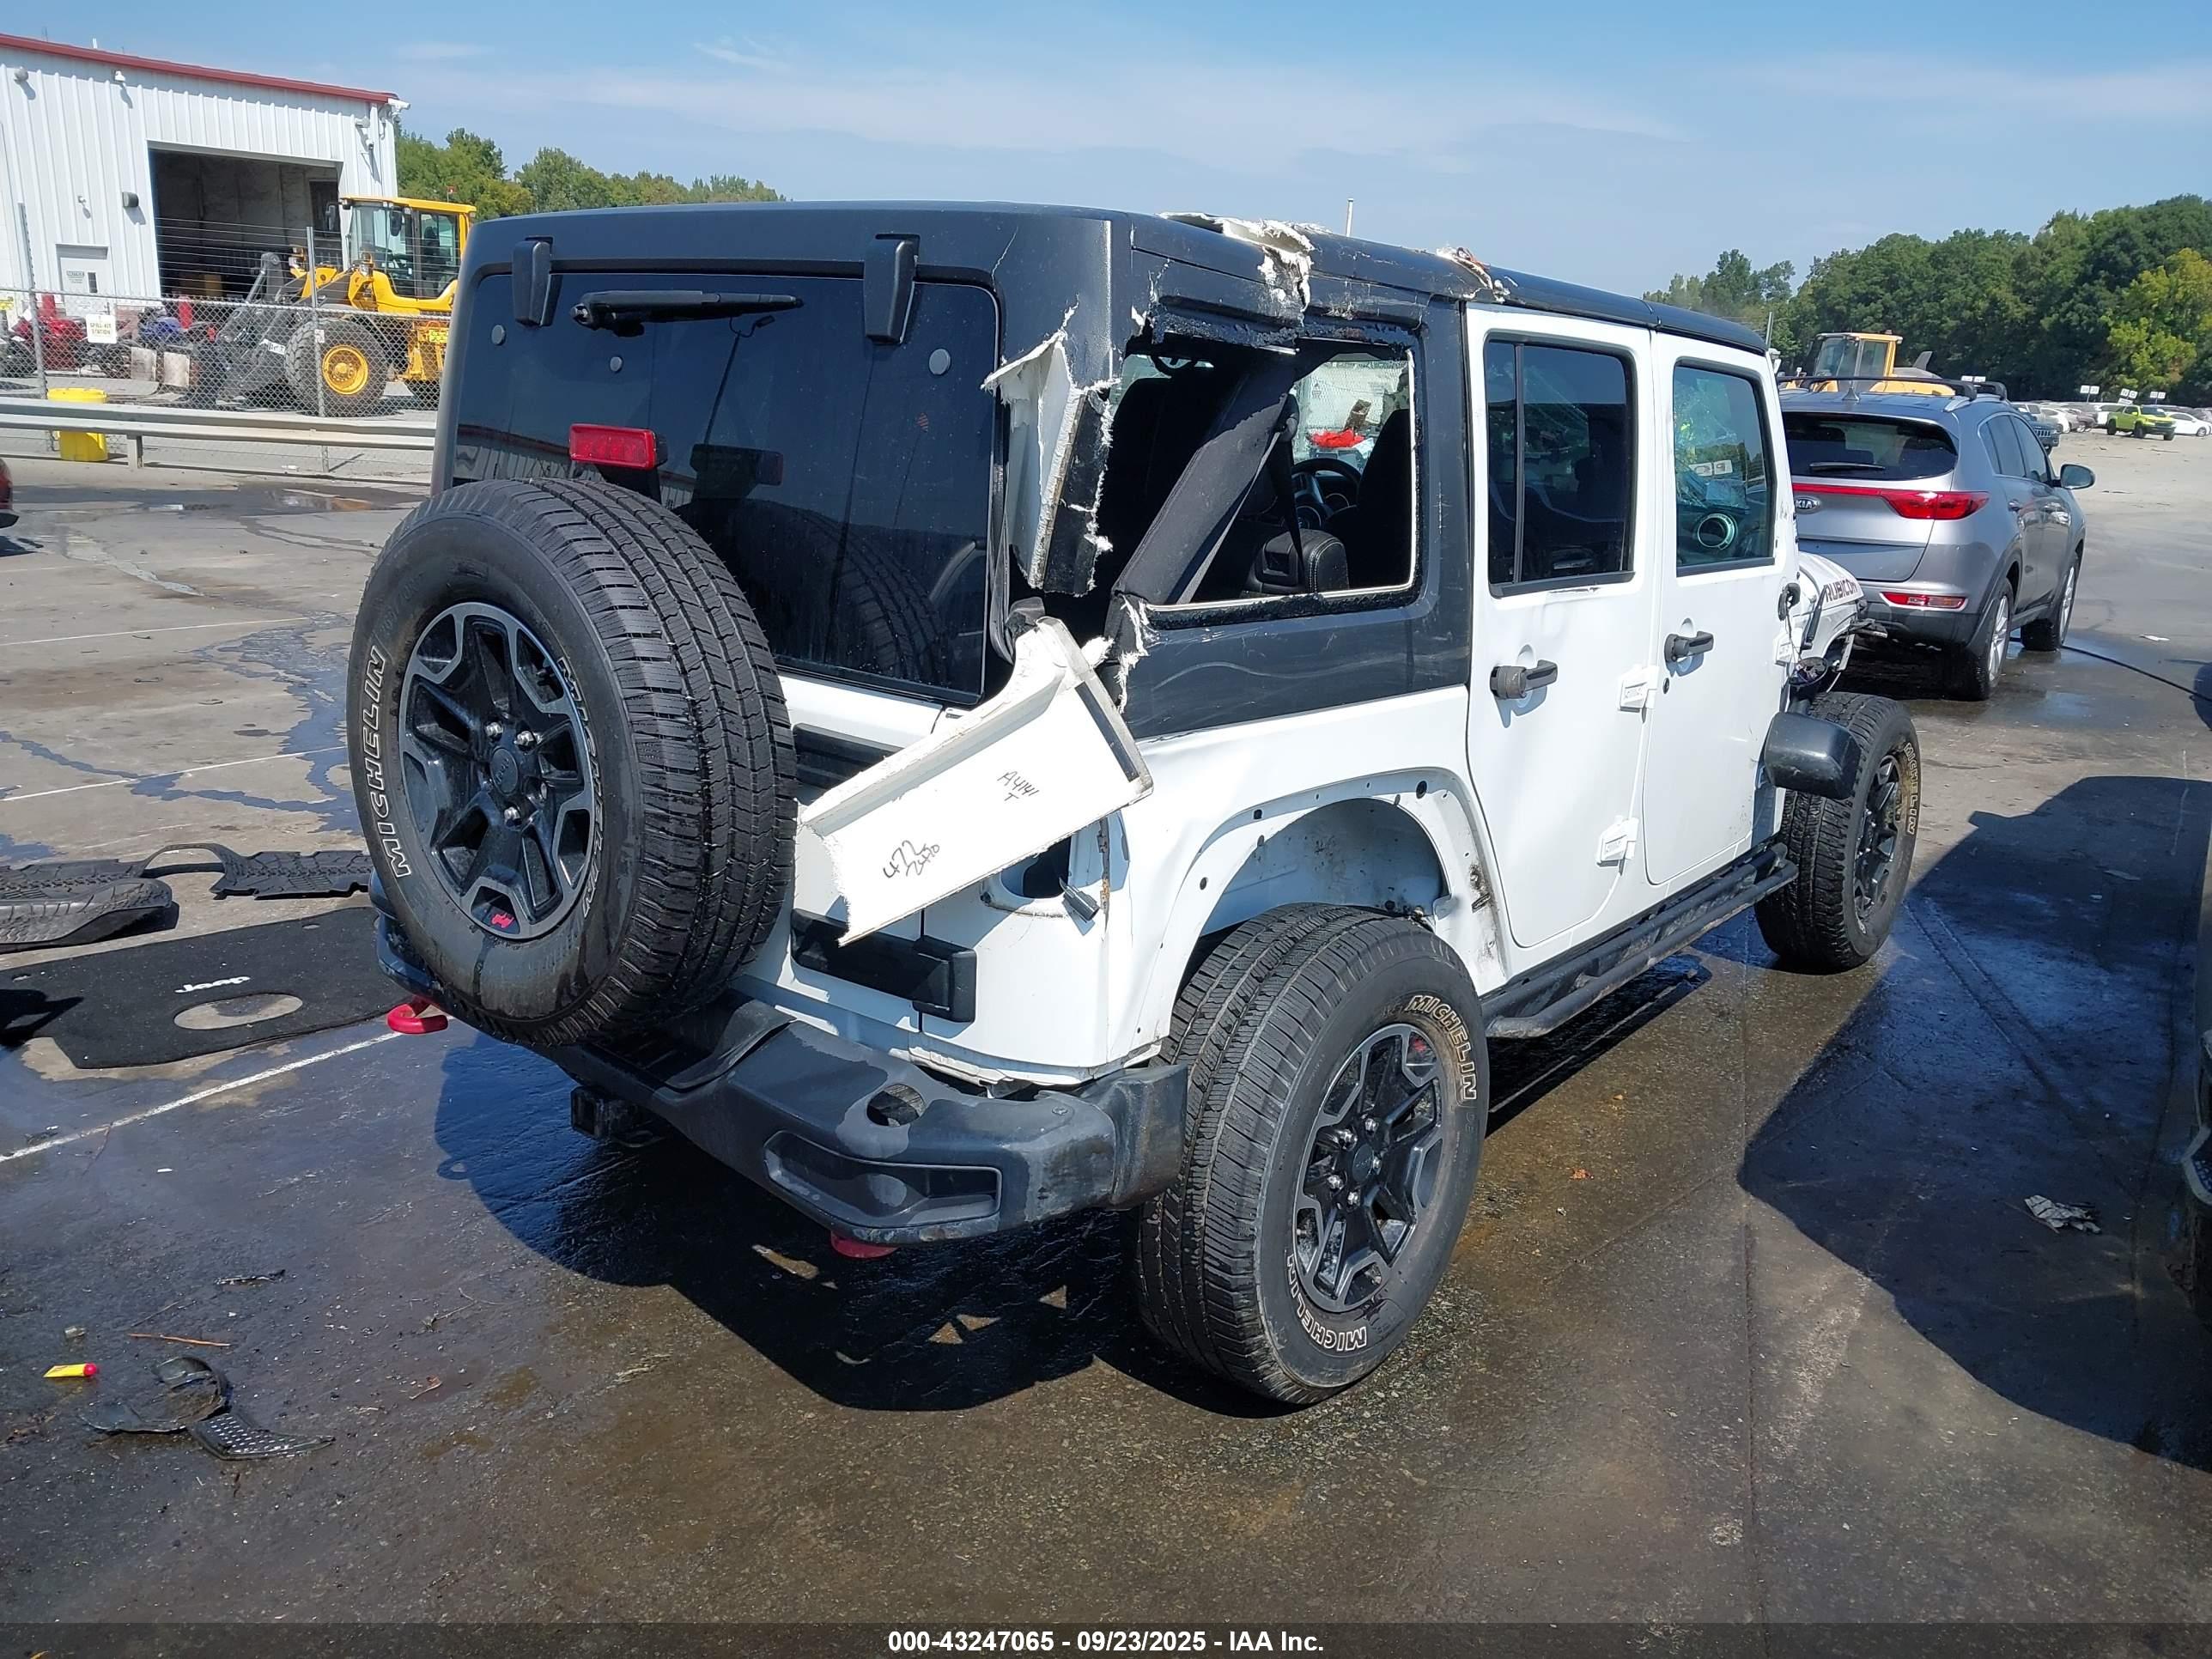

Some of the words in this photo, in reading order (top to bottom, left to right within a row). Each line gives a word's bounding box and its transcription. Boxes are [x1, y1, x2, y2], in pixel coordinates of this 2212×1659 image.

[1795, 497, 1814, 509] KIA
[1826, 579, 1858, 602] RUBICON
[363, 646, 411, 878] MICHELIN
[174, 976, 251, 993] Jeep
[1405, 994, 1477, 1100] MICHELIN
[1286, 1254, 1367, 1352] MICHELIN
